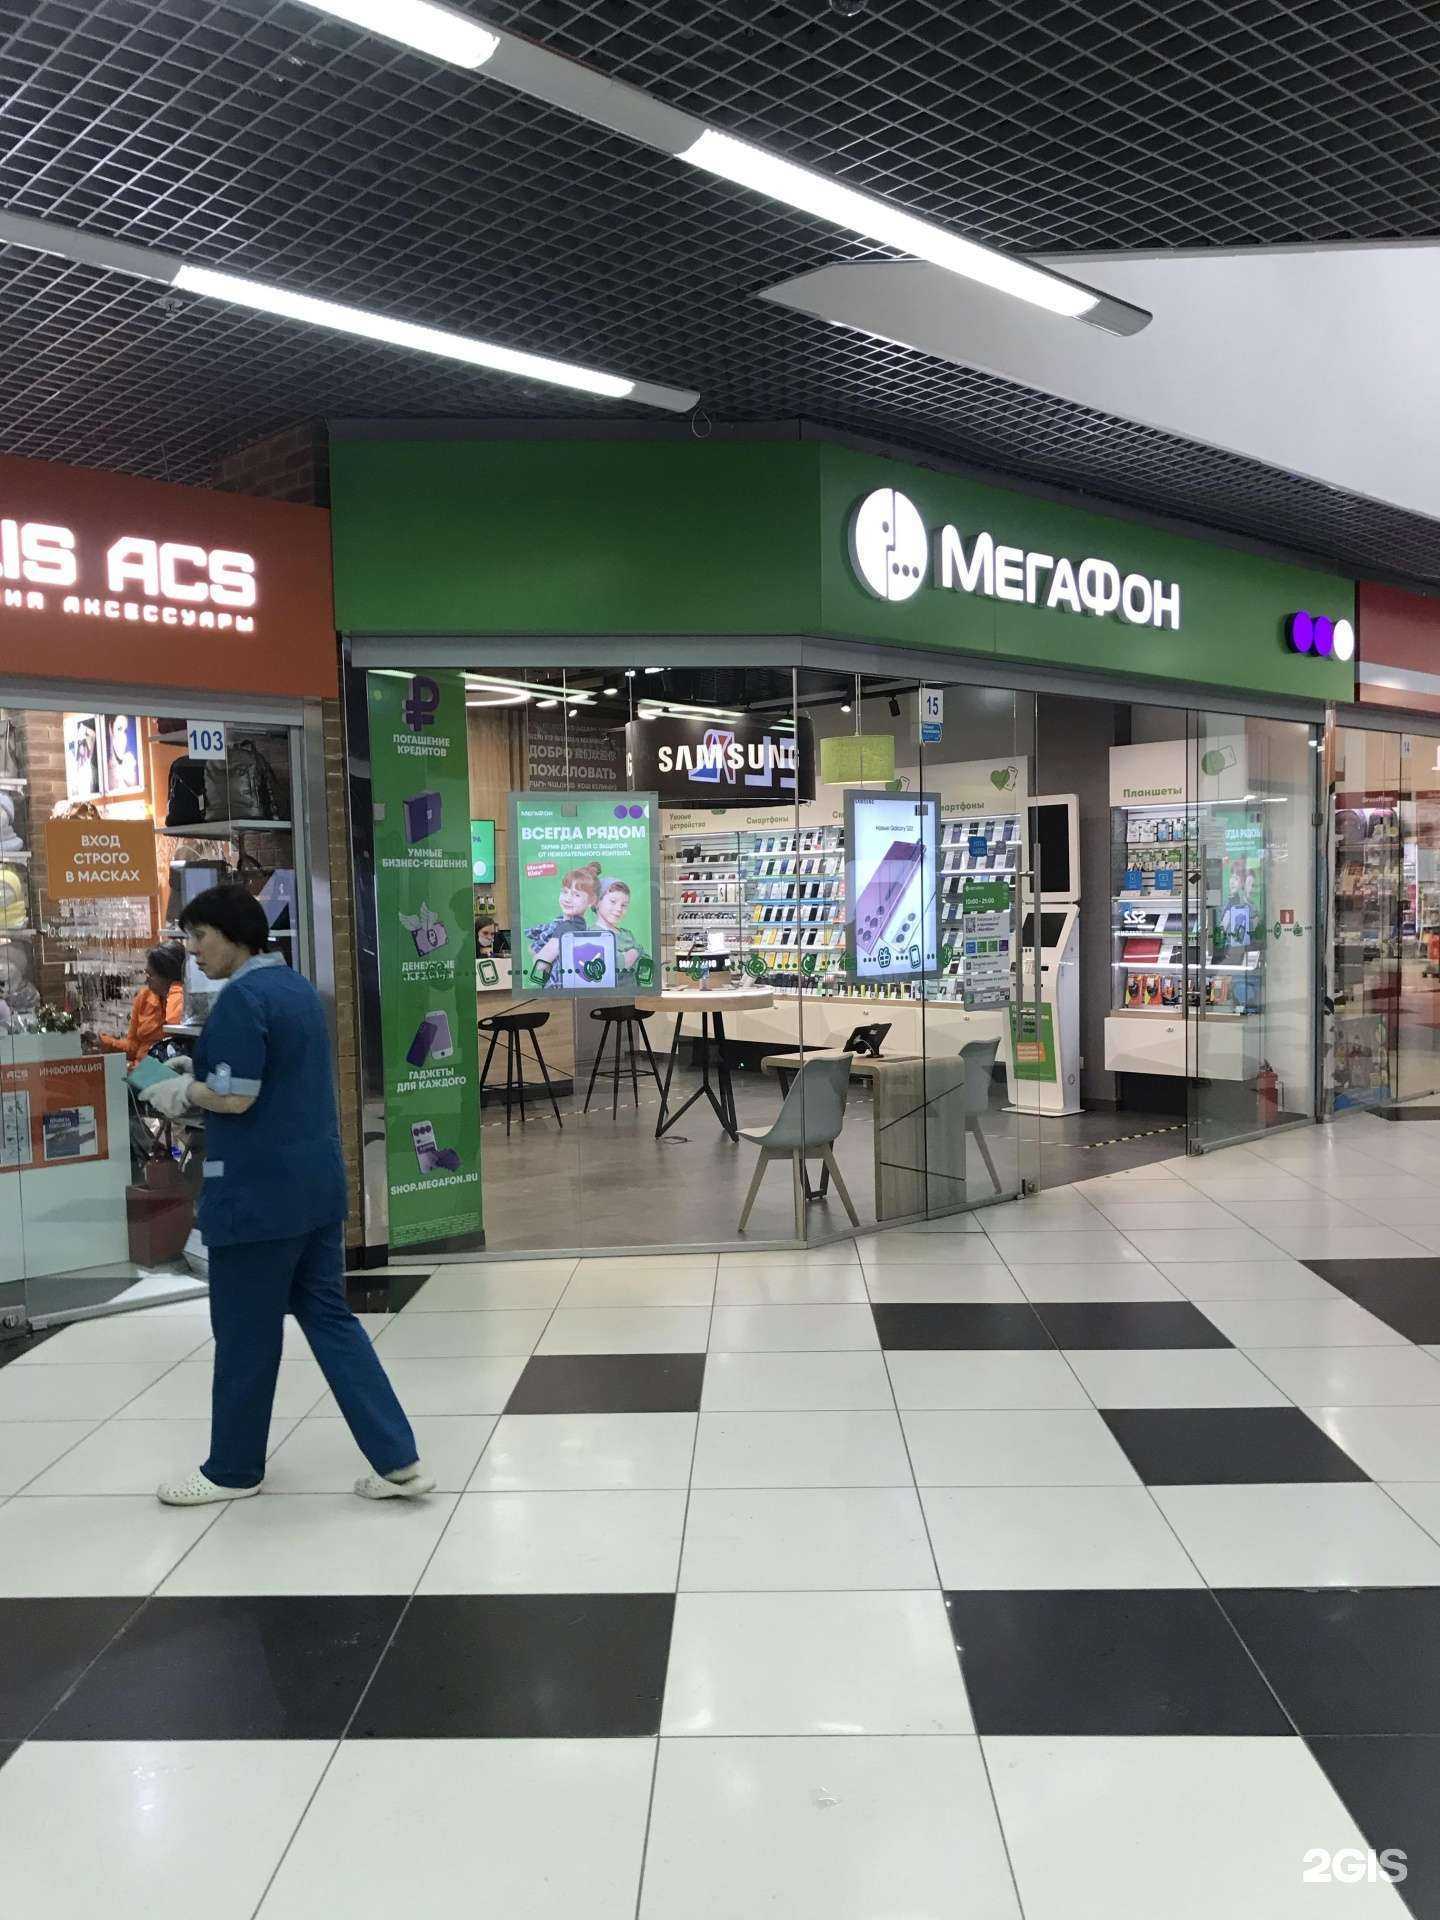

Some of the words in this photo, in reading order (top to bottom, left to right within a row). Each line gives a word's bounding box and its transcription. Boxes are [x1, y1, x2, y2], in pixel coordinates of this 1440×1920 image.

[0, 519, 77, 586] IS
[106, 536, 257, 607] ACS
[926, 695, 939, 716] 15
[189, 729, 224, 752] 103
[393, 733, 450, 747] ПОГАШЕНИЕ
[397, 744, 447, 757] КРЕДИТОВ
[528, 744, 573, 760] ДОБРО
[658, 743, 800, 773] SAMSUNG
[528, 763, 617, 780] ПОЖАЛОВАТЬ
[1123, 787, 1183, 798] Планшеты
[746, 816, 789, 827] Смартфоны
[521, 826, 583, 841] ВСЕГДА
[586, 825, 646, 841] РЯДОМ
[81, 835, 121, 848] ВХОД
[73, 852, 130, 865] СТРОГО
[408, 848, 443, 858] УМНЫЕ
[382, 858, 468, 868] БИЗНЕС-РЕШЕНИЯ
[66, 871, 75, 882] В
[78, 870, 140, 882] МАСКАХ
[40, 1062, 103, 1076] ИНФОРМАЦИЯ
[408, 1067, 454, 1080] ГАДЖЕТЫ
[397, 1081, 417, 1093] ДЛЯ
[418, 1076, 467, 1090] КАЖДОГО
[390, 1172, 478, 1196] SHOP.MEGAFON.RU
